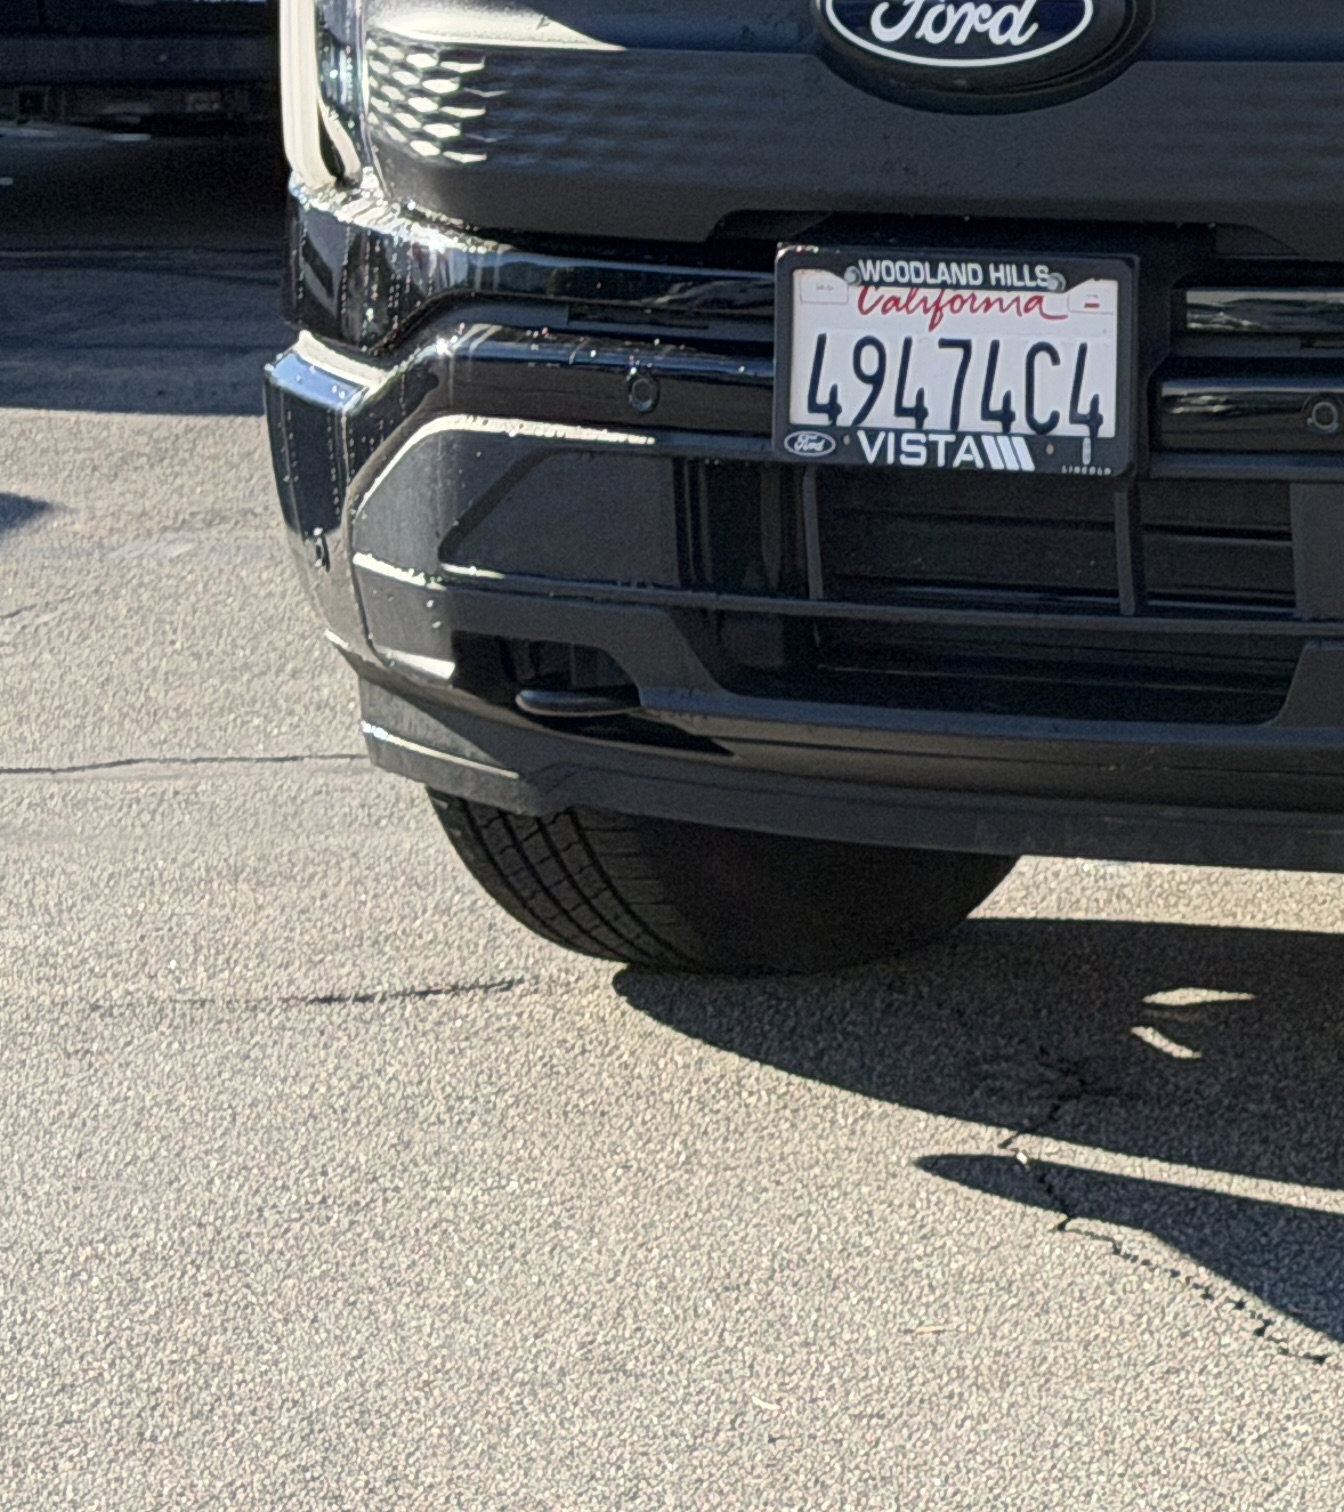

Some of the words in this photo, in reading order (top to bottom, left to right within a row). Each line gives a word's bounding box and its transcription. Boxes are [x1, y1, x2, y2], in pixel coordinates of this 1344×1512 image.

[858, 259, 983, 287] WOODLAND
[989, 264, 1051, 289] HILLS
[857, 286, 1068, 332] California
[807, 333, 1104, 438] 49474C4
[792, 434, 825, 453] Ford
[857, 430, 985, 469] VISTA
